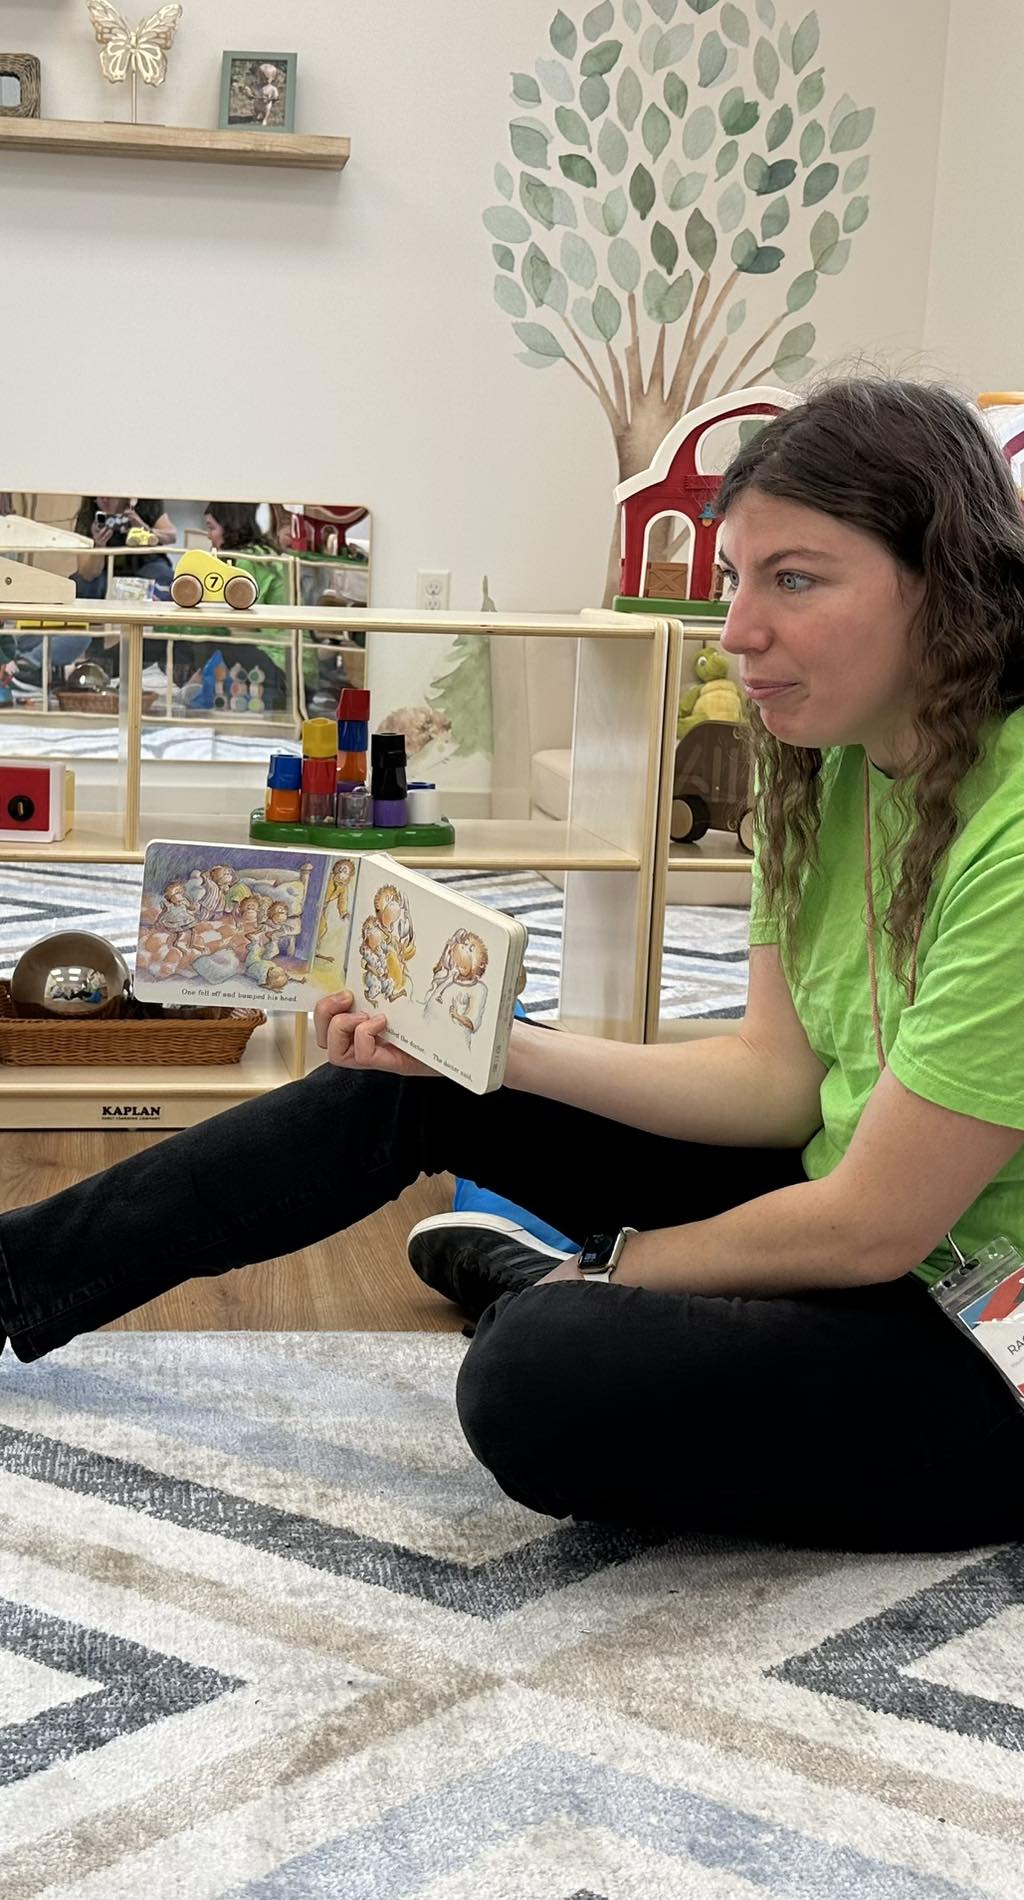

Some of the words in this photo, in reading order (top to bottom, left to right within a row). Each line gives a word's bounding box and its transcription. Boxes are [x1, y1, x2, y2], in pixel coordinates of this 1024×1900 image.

[209, 576, 219, 588] 7
[102, 1105, 161, 1116] KAPLAN
[1007, 1336, 1024, 1356] RA
